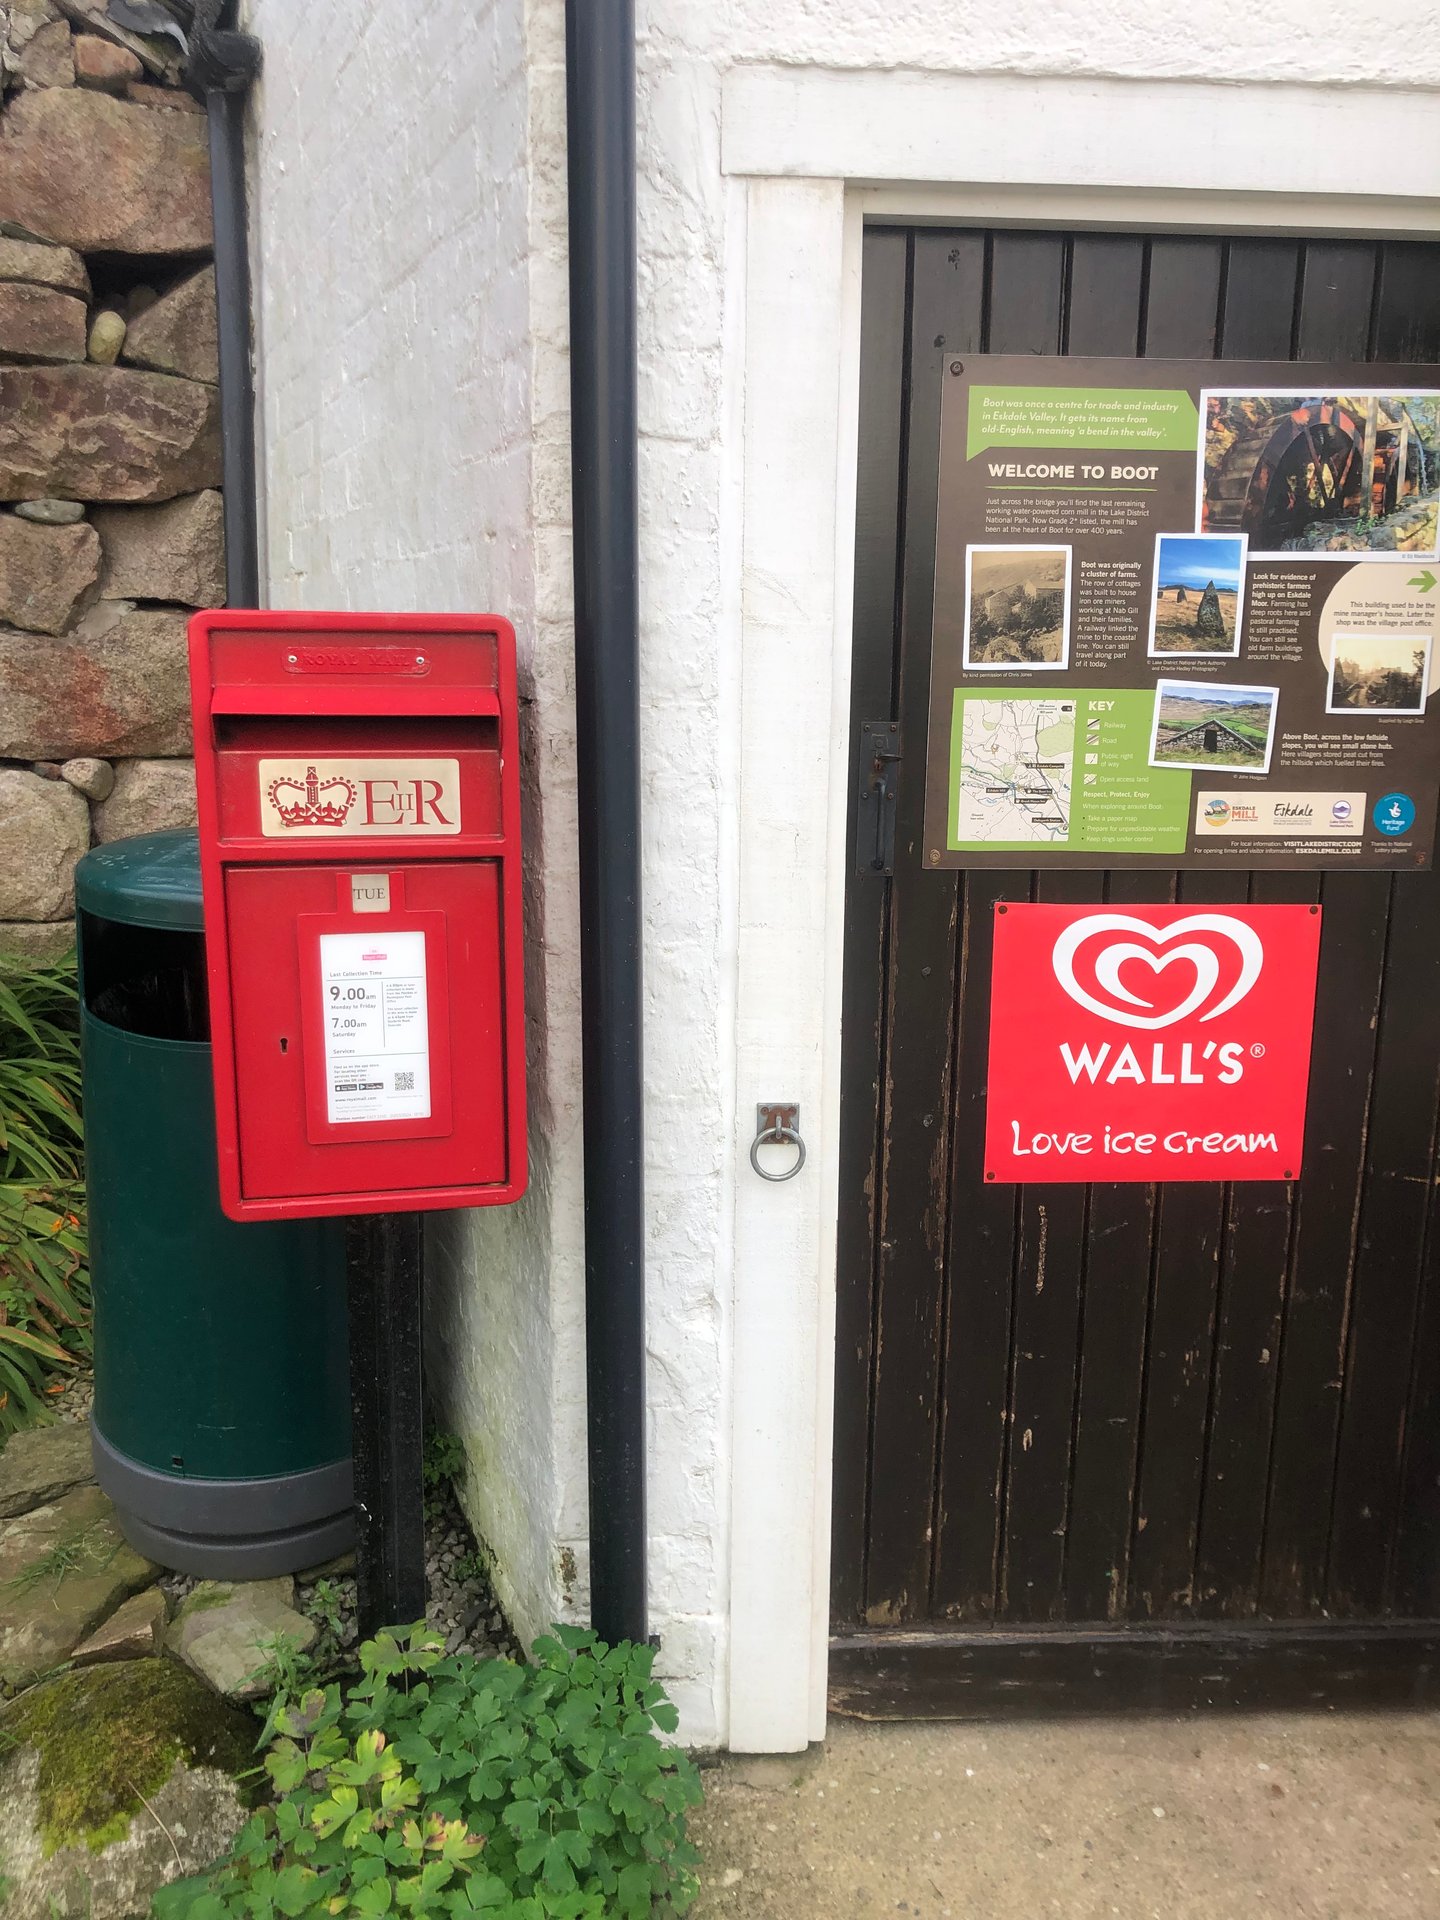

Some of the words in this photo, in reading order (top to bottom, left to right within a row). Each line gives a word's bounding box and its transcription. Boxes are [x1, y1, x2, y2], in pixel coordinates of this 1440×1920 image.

[983, 398, 1004, 407] Boot
[1084, 400, 1097, 409] for
[1099, 400, 1122, 409] trade
[1124, 401, 1141, 410] and
[1143, 401, 1178, 413] industry
[993, 411, 1027, 420] Eskdale
[1030, 412, 1057, 423] Valley.
[1060, 413, 1066, 421] It
[1068, 415, 1086, 424] gets
[1088, 414, 1098, 422] its
[1127, 415, 1147, 423] from
[982, 425, 1033, 436] old-English,
[1037, 426, 1075, 437] meaning
[1087, 427, 1109, 435] bend
[988, 464, 1074, 478] WELCOME
[1081, 466, 1104, 479] TO
[1111, 466, 1158, 479] BOOT
[1114, 500, 1145, 508] remaining
[1112, 562, 1141, 570] originally
[304, 654, 359, 666] ROYAL
[369, 654, 410, 666] MAIL
[1089, 701, 1114, 710] KEY
[1274, 803, 1313, 817] Eskdale
[353, 888, 385, 899] TUE
[330, 986, 376, 1001] 9.00am
[332, 1018, 367, 1028] 7.00am
[1059, 1040, 1245, 1085] WALL'S
[1010, 1120, 1093, 1156] Love
[1104, 1125, 1157, 1154] ice
[1164, 1131, 1278, 1153] cream
